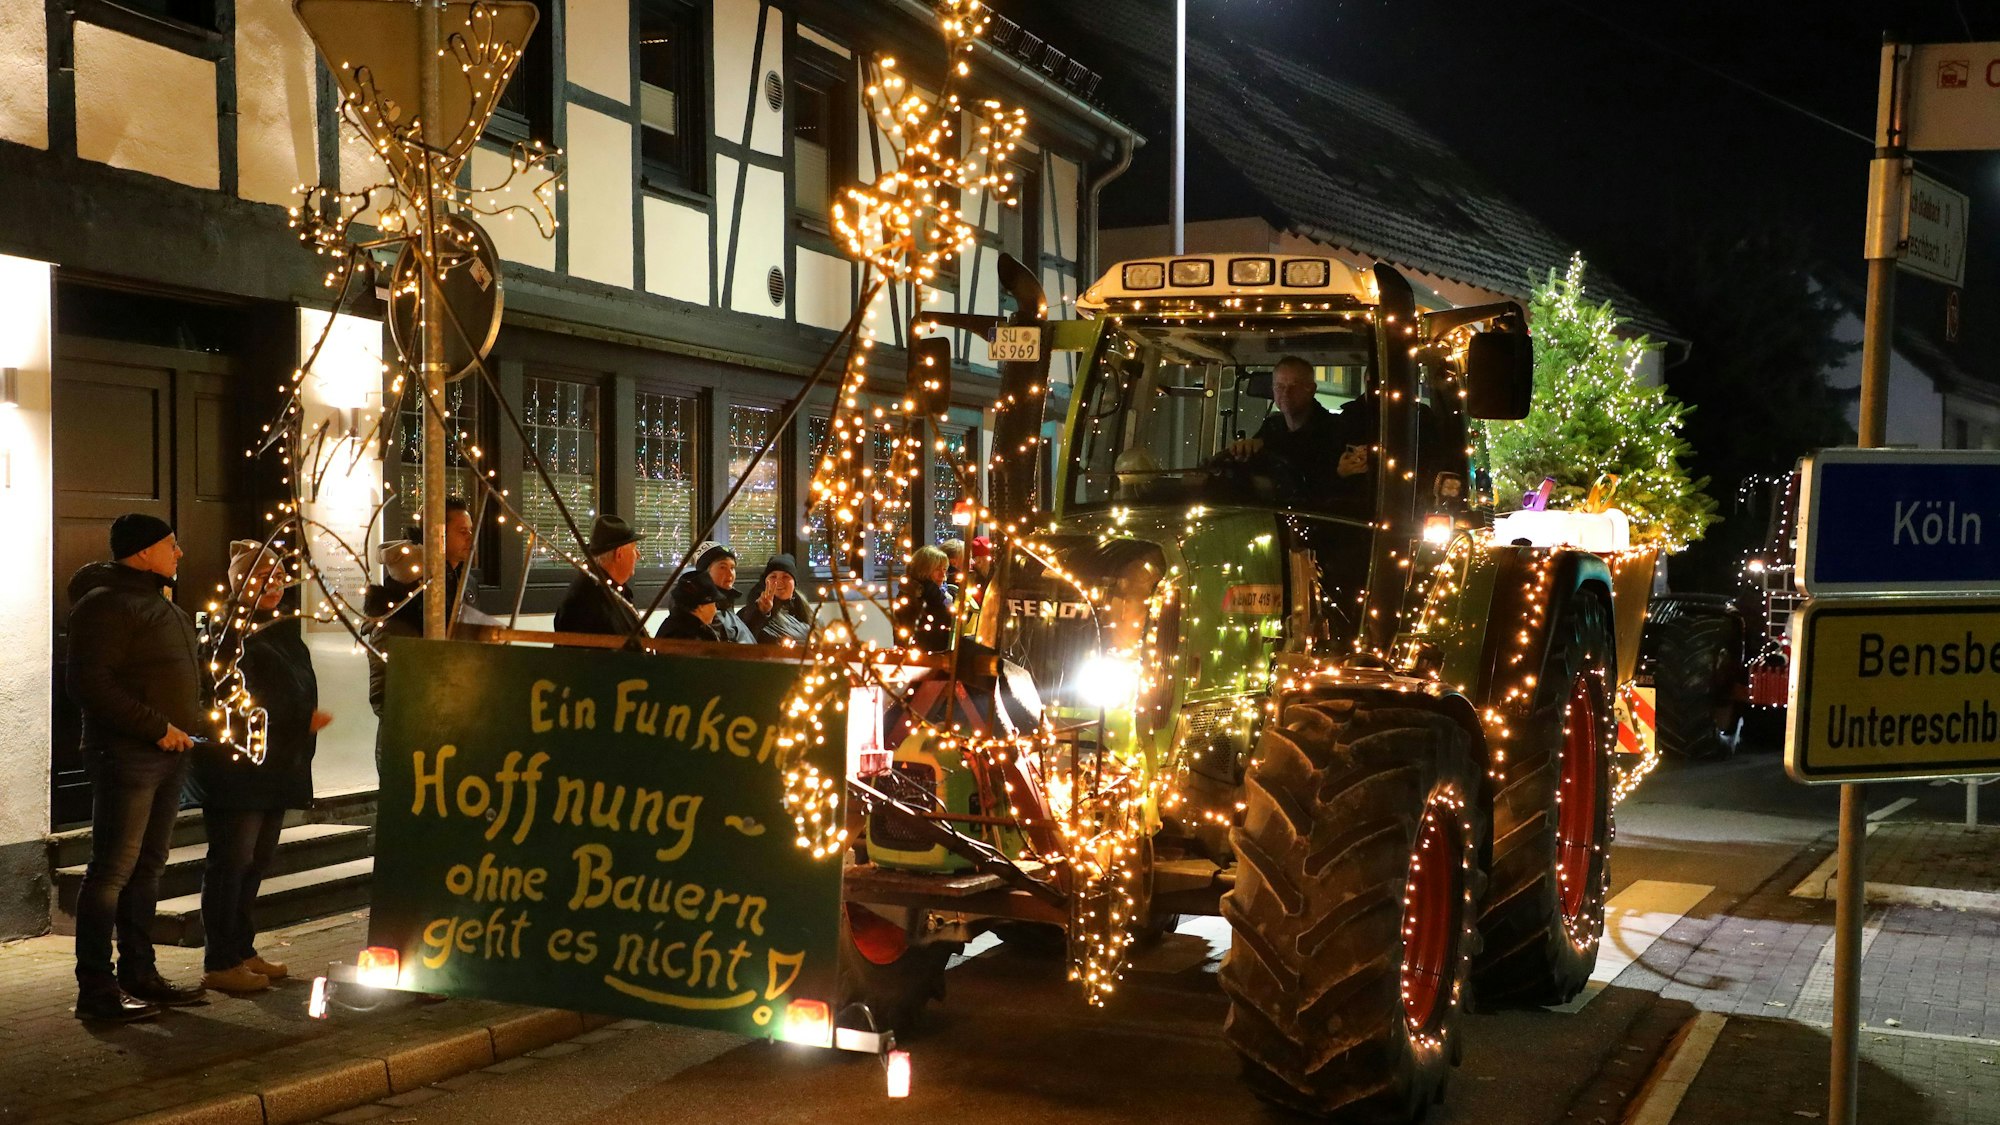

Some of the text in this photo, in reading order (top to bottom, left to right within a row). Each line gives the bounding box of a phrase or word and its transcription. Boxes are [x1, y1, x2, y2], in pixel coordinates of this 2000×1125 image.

[991, 345, 1034, 359] WS 969
[1001, 329, 1017, 343] SU
[1892, 500, 1982, 545] Köln
[1008, 599, 1092, 619] FENDT
[530, 679, 596, 734] Ein
[411, 744, 705, 862] Hoffnung
[445, 843, 768, 936] ohne Bauern
[422, 908, 533, 969] geht
[547, 927, 598, 965] es
